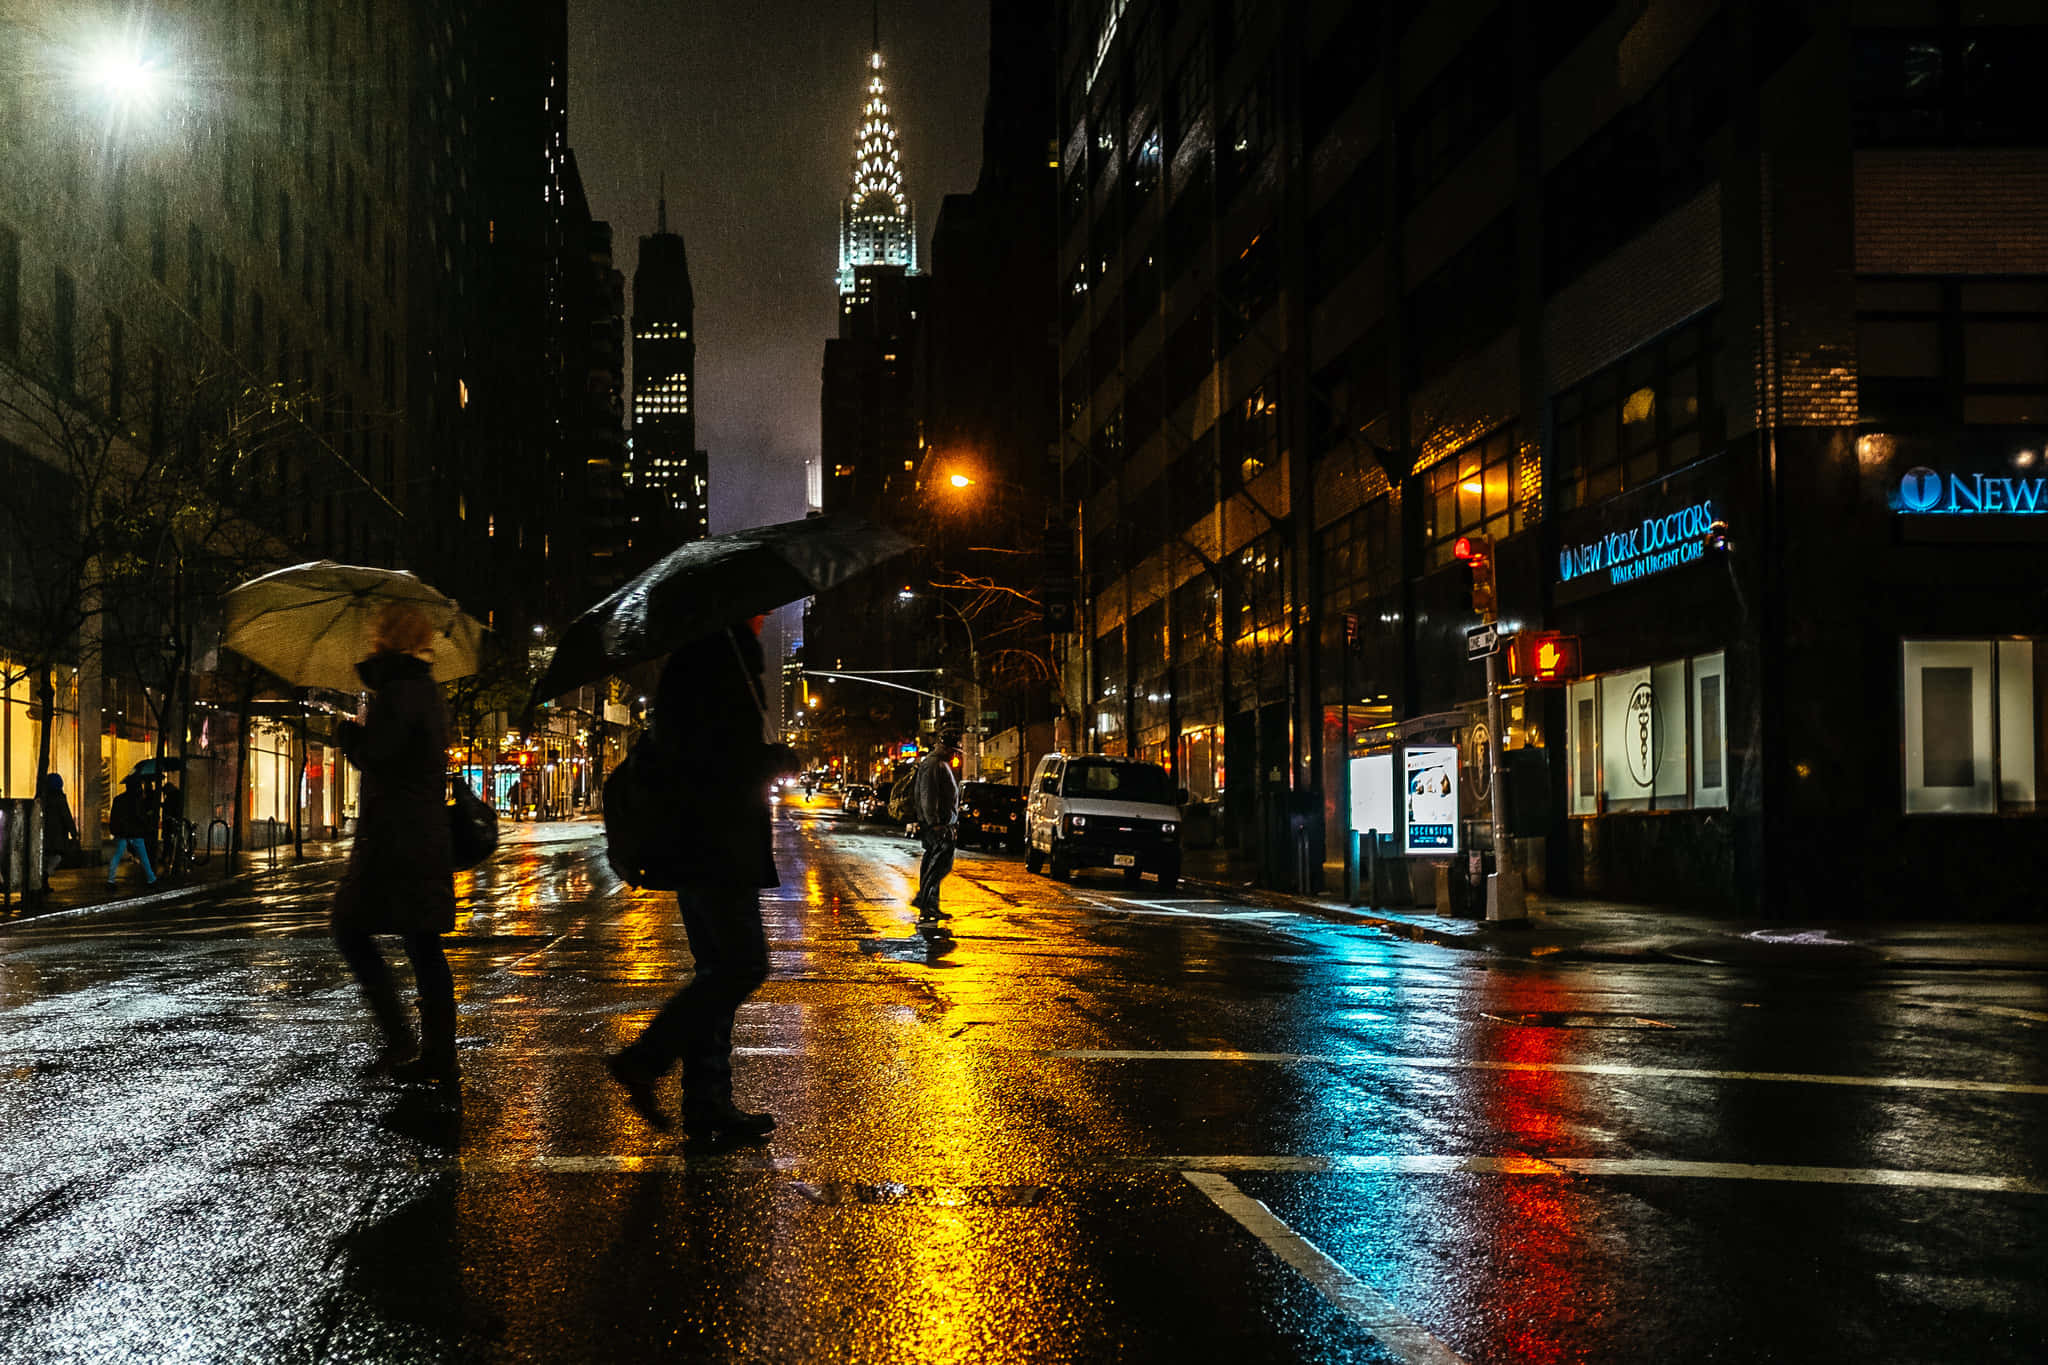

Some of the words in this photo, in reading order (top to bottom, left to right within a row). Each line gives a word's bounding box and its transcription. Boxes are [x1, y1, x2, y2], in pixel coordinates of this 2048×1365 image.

[1948, 472, 2046, 512] NEW
[1573, 541, 1603, 578] NEW
[1604, 528, 1641, 566] YORK
[1642, 499, 1714, 554] DOCTORS
[1611, 557, 1645, 585] WALK-IN
[1645, 547, 1680, 575] URGENT
[1680, 539, 1704, 564] CARE
